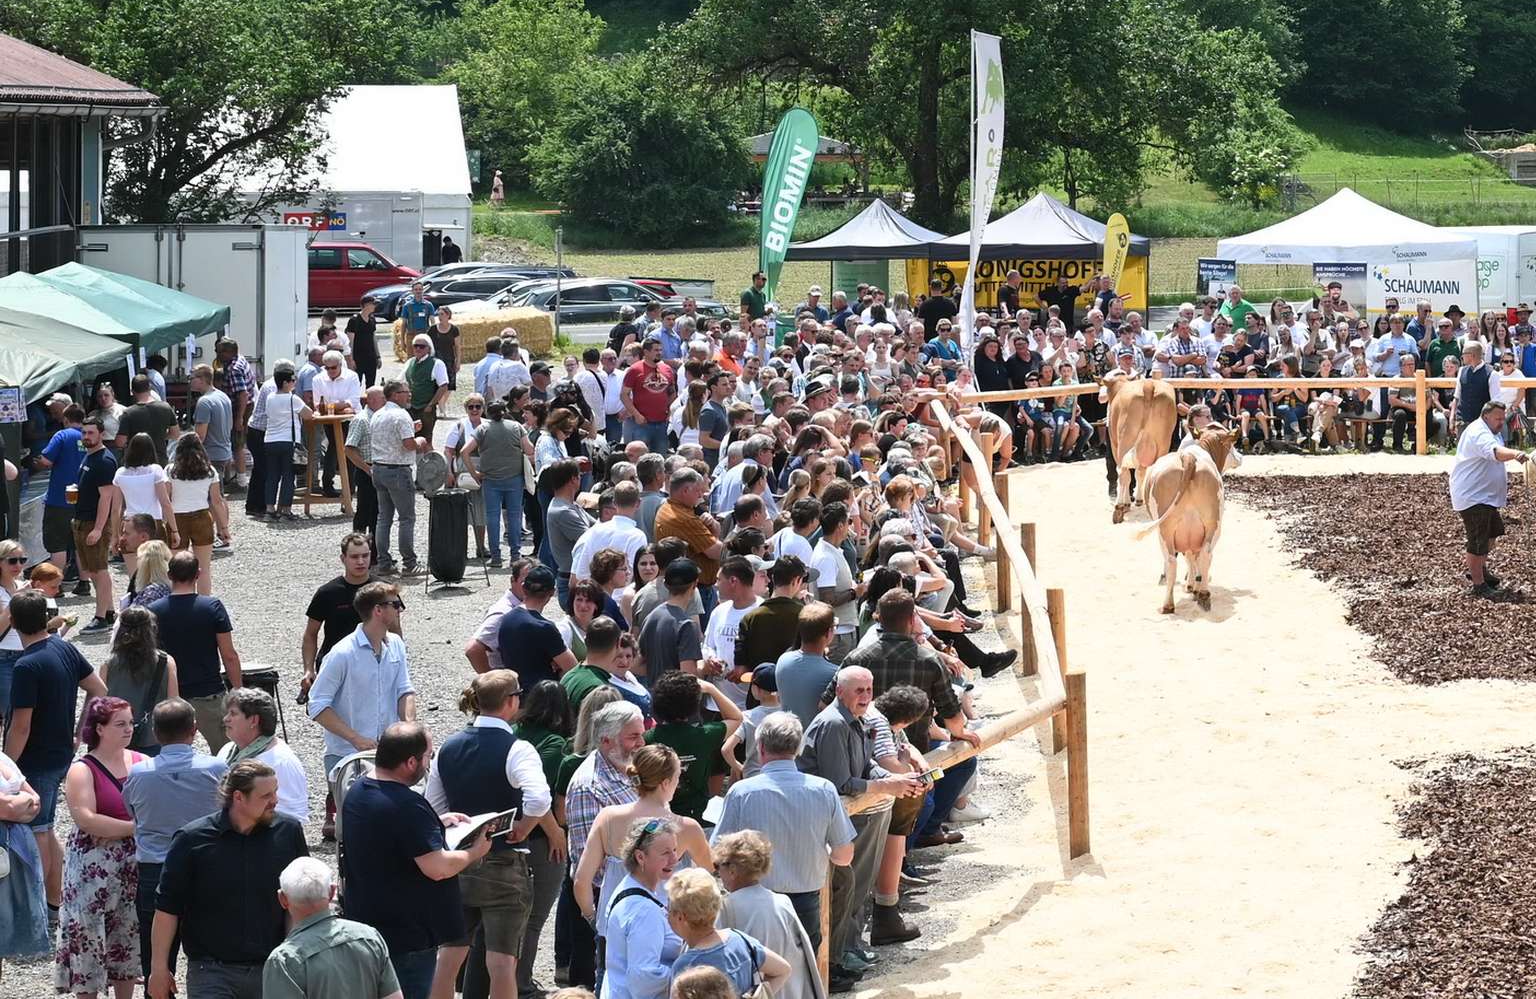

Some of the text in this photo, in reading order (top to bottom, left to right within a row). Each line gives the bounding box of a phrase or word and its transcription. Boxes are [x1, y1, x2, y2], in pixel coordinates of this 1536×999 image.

[765, 143, 813, 253] BIOMIN
[329, 215, 346, 227] NÖ
[1396, 251, 1428, 259] SCHAUMANN
[1384, 278, 1460, 295] SCHAUMANN
